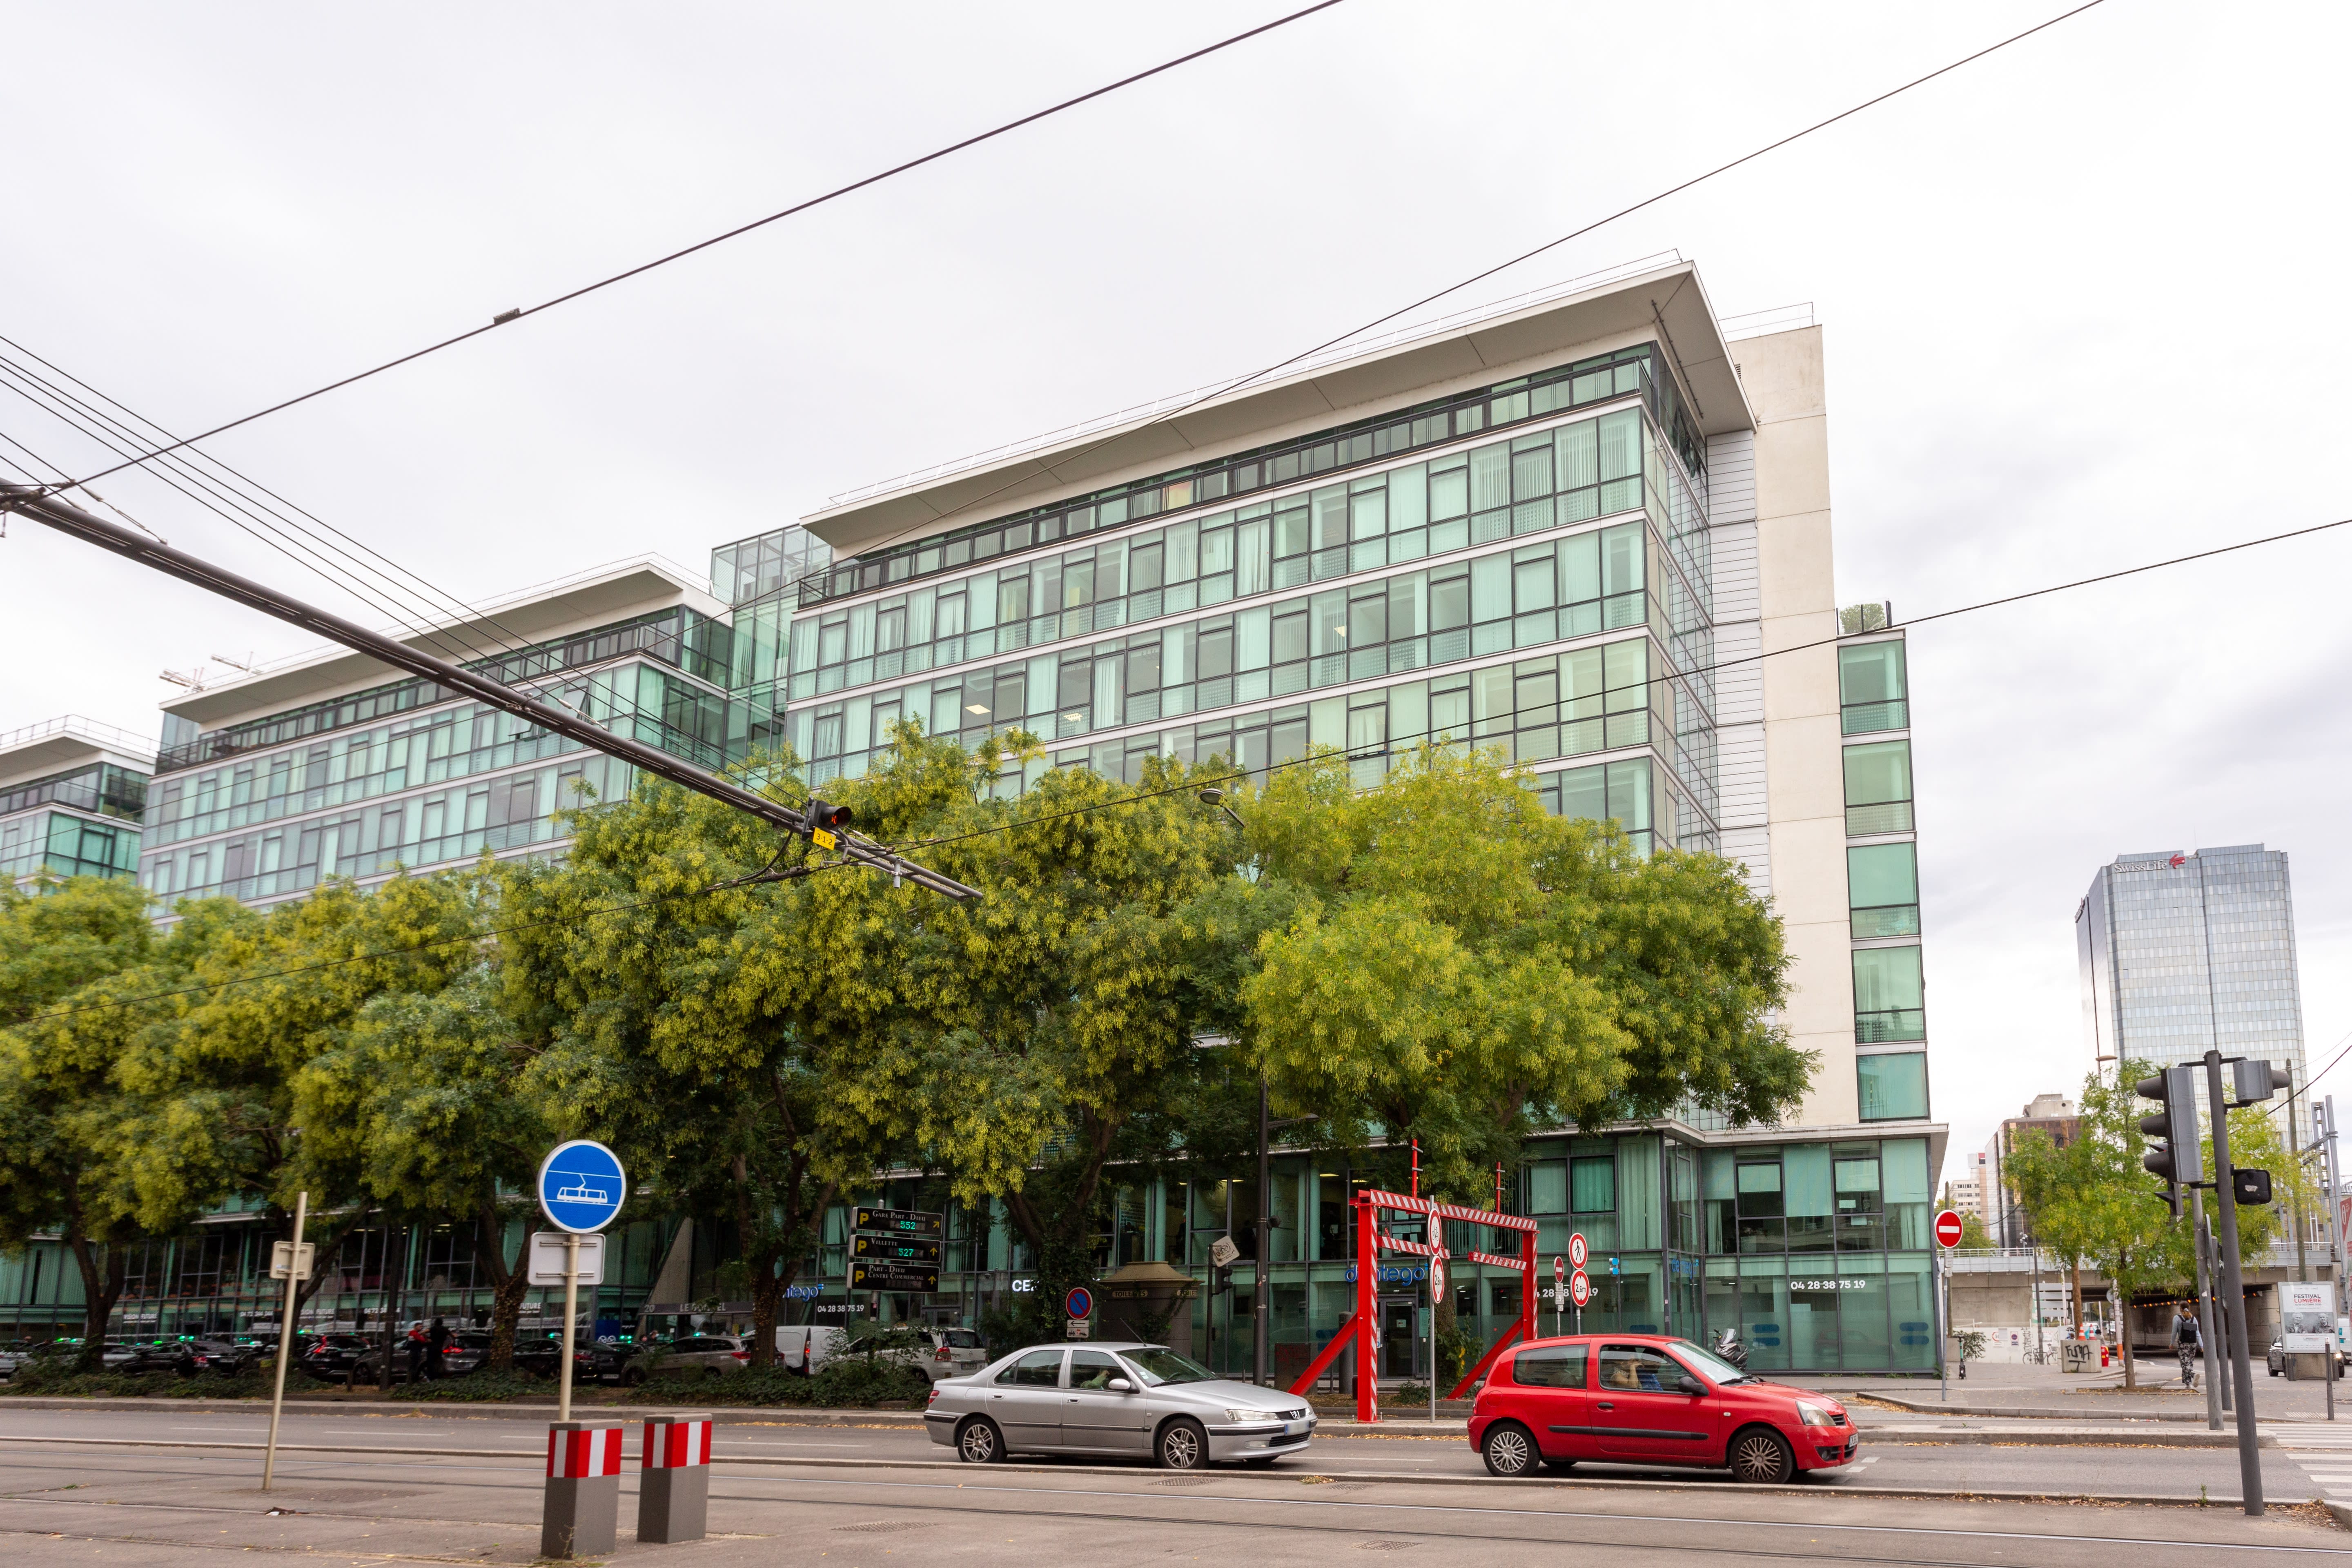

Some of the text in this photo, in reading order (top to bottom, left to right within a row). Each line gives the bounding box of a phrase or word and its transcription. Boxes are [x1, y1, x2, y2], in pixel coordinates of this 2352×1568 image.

[860, 1212, 869, 1225] P
[872, 1210, 889, 1218] GARE
[900, 1221, 916, 1230] 552
[858, 1240, 867, 1252] P
[871, 1238, 898, 1246] VILLETTE
[898, 1248, 915, 1257] 527
[855, 1270, 865, 1283] P
[890, 1272, 924, 1281] COMMERCIAL
[1344, 1265, 1425, 1286] dtego
[1575, 1284, 1586, 1293] 2,6m
[1791, 1280, 1866, 1290] 04 28 38 75 19
[782, 1285, 818, 1302] ntego
[1542, 1289, 1555, 1297] 28
[1564, 1288, 1569, 1297] 8
